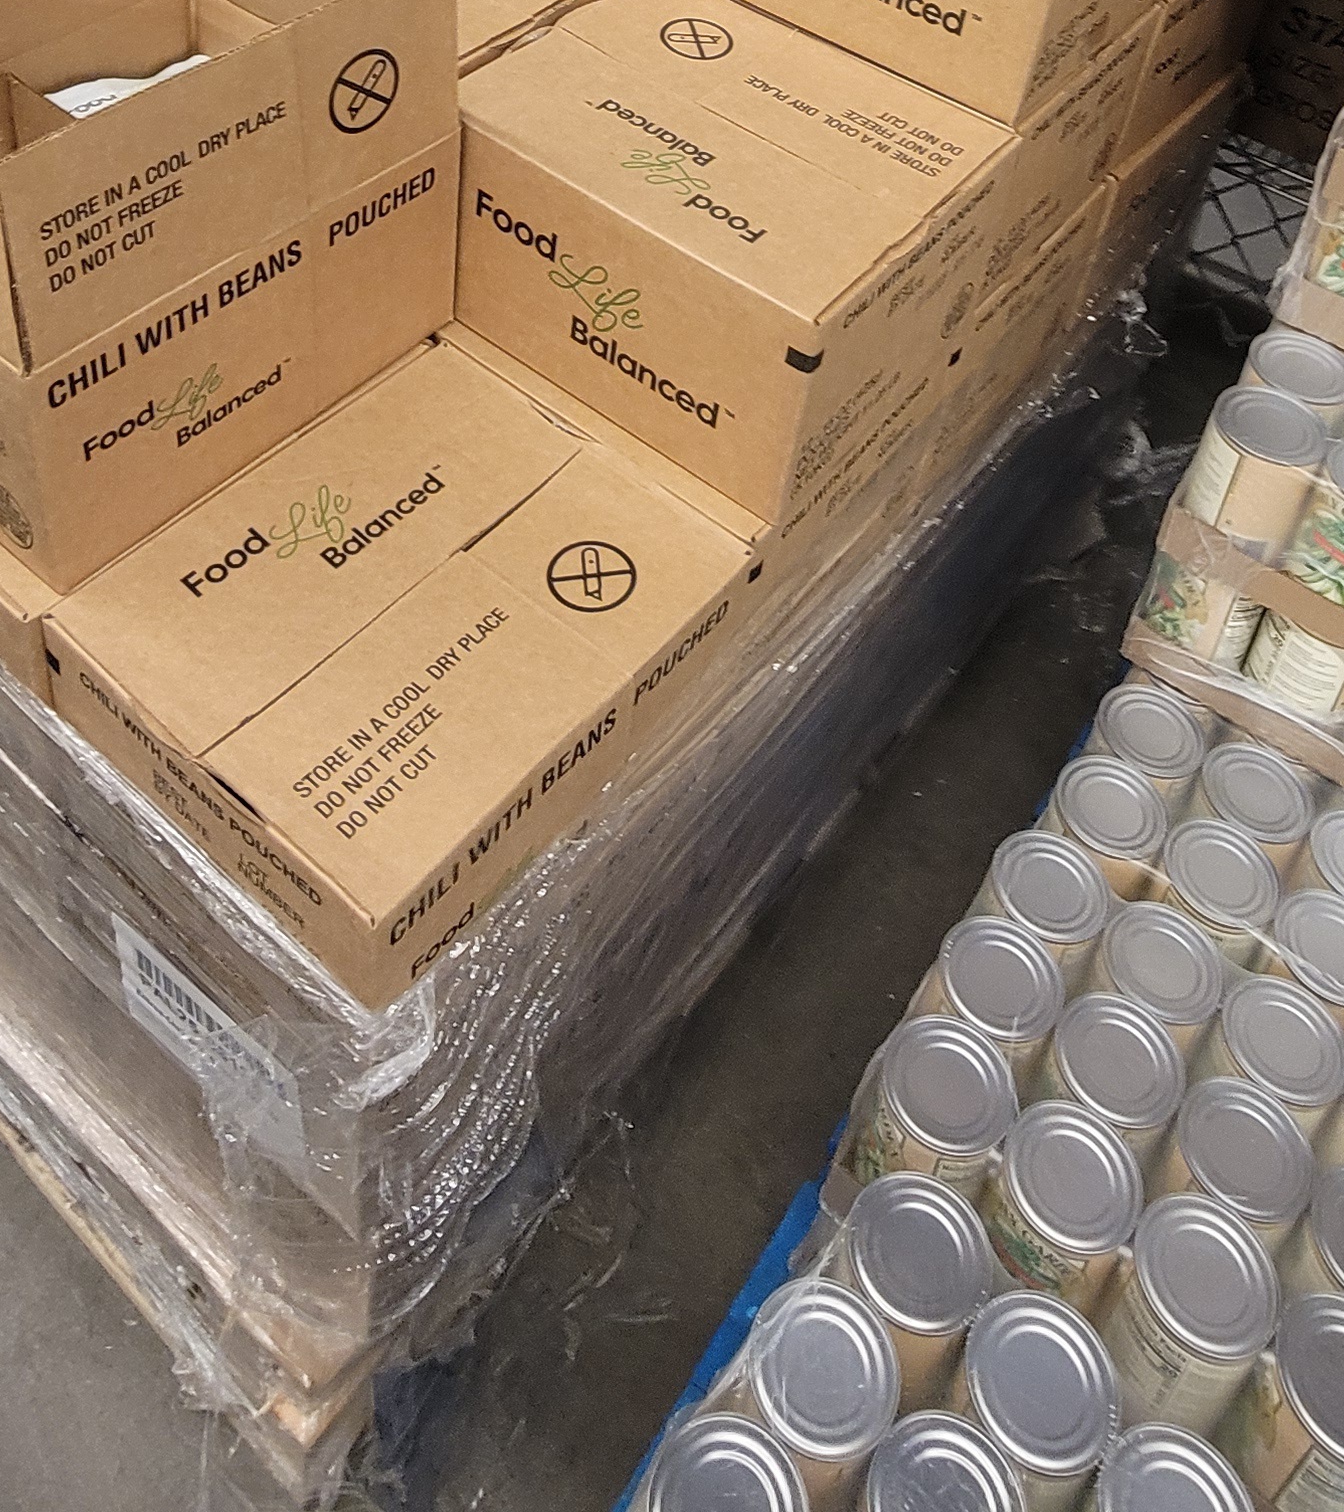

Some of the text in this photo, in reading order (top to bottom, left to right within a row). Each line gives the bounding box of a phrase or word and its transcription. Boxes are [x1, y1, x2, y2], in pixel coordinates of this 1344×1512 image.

[39, 100, 288, 243] STORE IN A COOL DRY PLACE
[595, 98, 718, 169] Balanced
[742, 73, 943, 179] STORE IN A COOL DRY PLACE
[840, 107, 955, 169] DO NOT FREEZE
[875, 109, 966, 157] DO NOT CUT
[45, 179, 185, 268] DO NOT FREEZE
[48, 219, 158, 295] DO NOT CUT
[681, 191, 769, 245] Food
[46, 165, 438, 410] CHILI WITH BEANS POUCHED
[475, 188, 721, 430] Food Life Balanced
[82, 361, 285, 463] Food Life Balanced
[179, 471, 447, 599] Food Life Balanced
[292, 606, 511, 800] STORE IN A COOL DRY PLACE
[79, 671, 323, 907] CHILI WITH BEANS POUCHED
[313, 702, 445, 820] DO NOT FREEZE
[335, 743, 440, 840] DO NOT CUT
[389, 599, 731, 947] CHILI WITH BEANS POUCHED
[239, 862, 306, 930] NUMBER
[410, 900, 476, 980] Food
